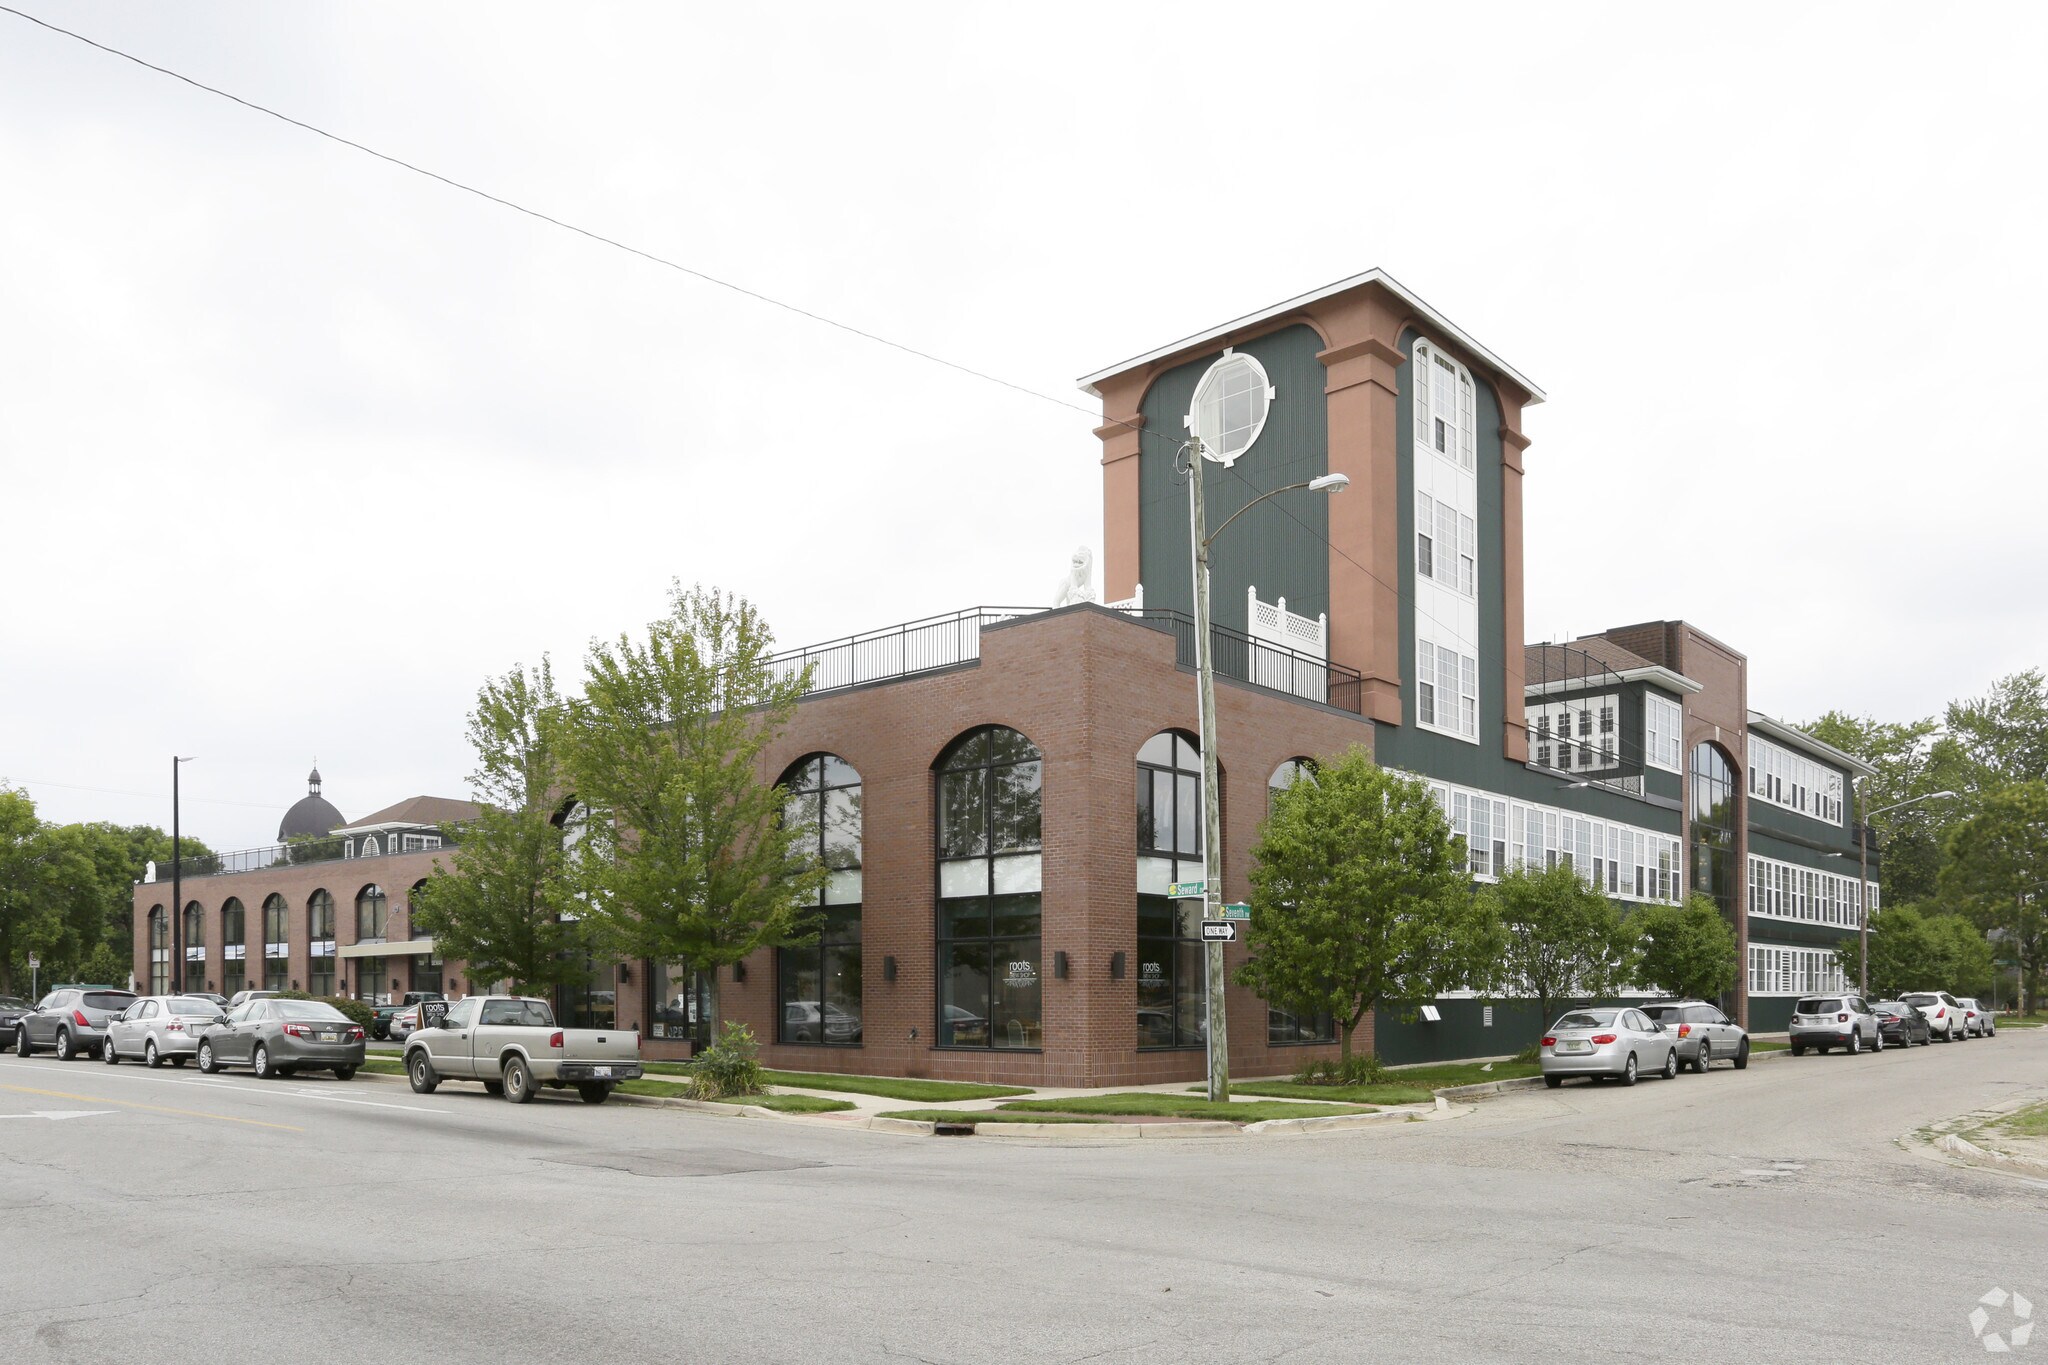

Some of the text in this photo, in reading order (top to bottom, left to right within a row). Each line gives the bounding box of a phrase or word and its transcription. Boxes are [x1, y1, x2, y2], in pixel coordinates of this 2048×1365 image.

[1177, 884, 1197, 895] Seward
[1225, 906, 1244, 918] Seventh
[1206, 927, 1228, 935] ONE WAY
[1009, 960, 1031, 971] roots
[1142, 961, 1160, 972] roots
[425, 1003, 445, 1012] roots
